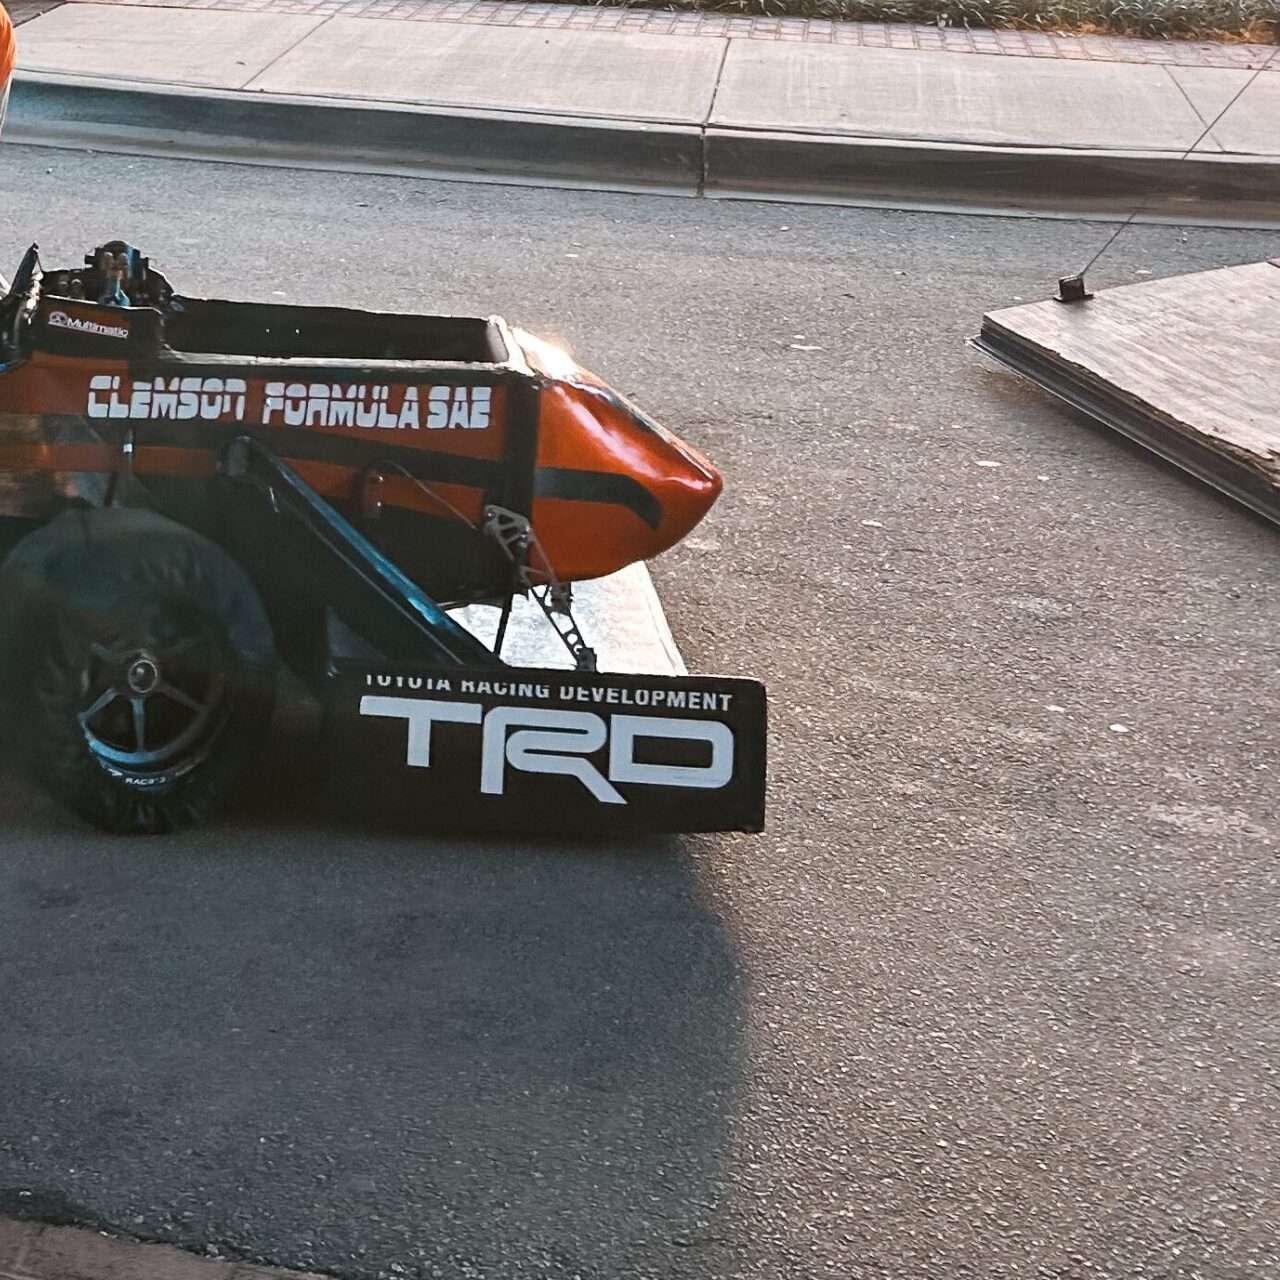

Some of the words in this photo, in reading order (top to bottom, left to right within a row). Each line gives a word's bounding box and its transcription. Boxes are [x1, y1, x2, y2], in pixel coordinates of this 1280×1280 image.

[87, 375, 247, 421] CLEMSON
[262, 381, 420, 430] FORMULA
[426, 385, 492, 430] SAE
[559, 685, 733, 712] DEVELOPMENT
[359, 695, 735, 805] TRD
